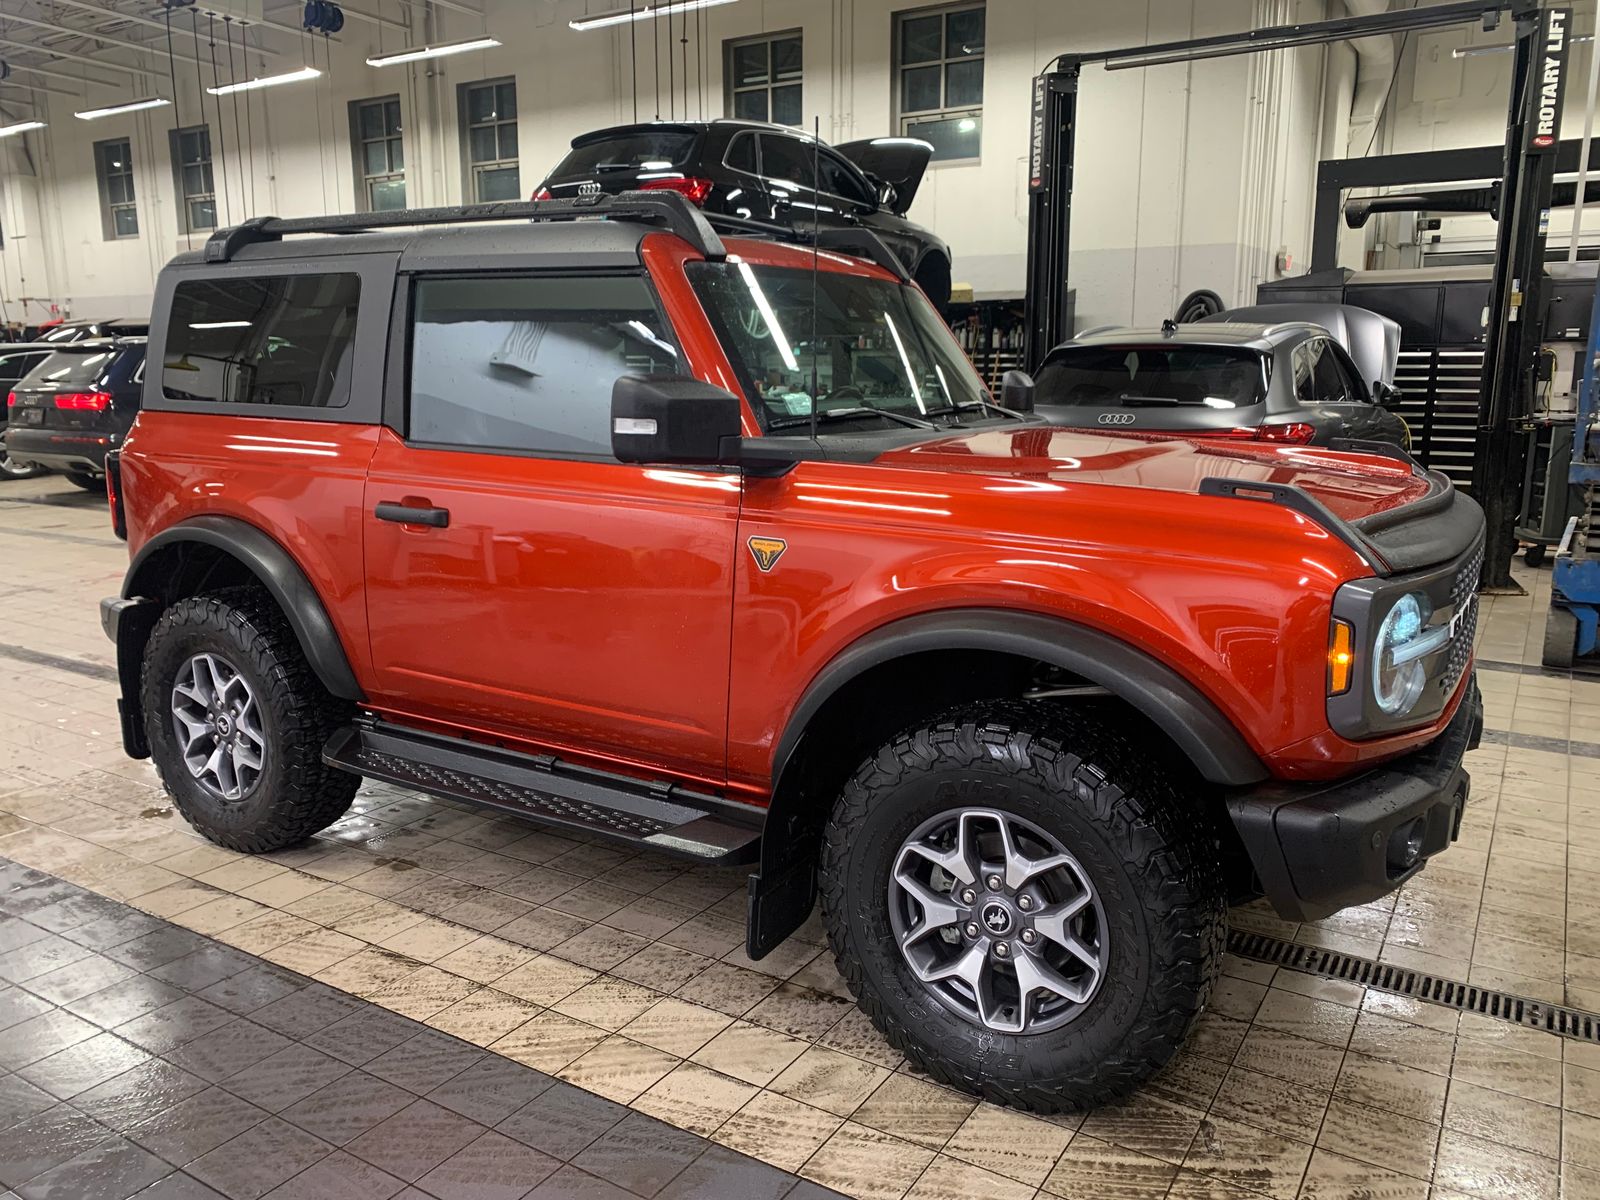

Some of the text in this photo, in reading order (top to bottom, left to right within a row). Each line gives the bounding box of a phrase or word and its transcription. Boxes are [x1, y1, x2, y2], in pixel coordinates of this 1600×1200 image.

[1035, 78, 1044, 111] LIFT
[1537, 10, 1566, 134] ROTARY LIFT
[1032, 116, 1043, 178] ROTARY
